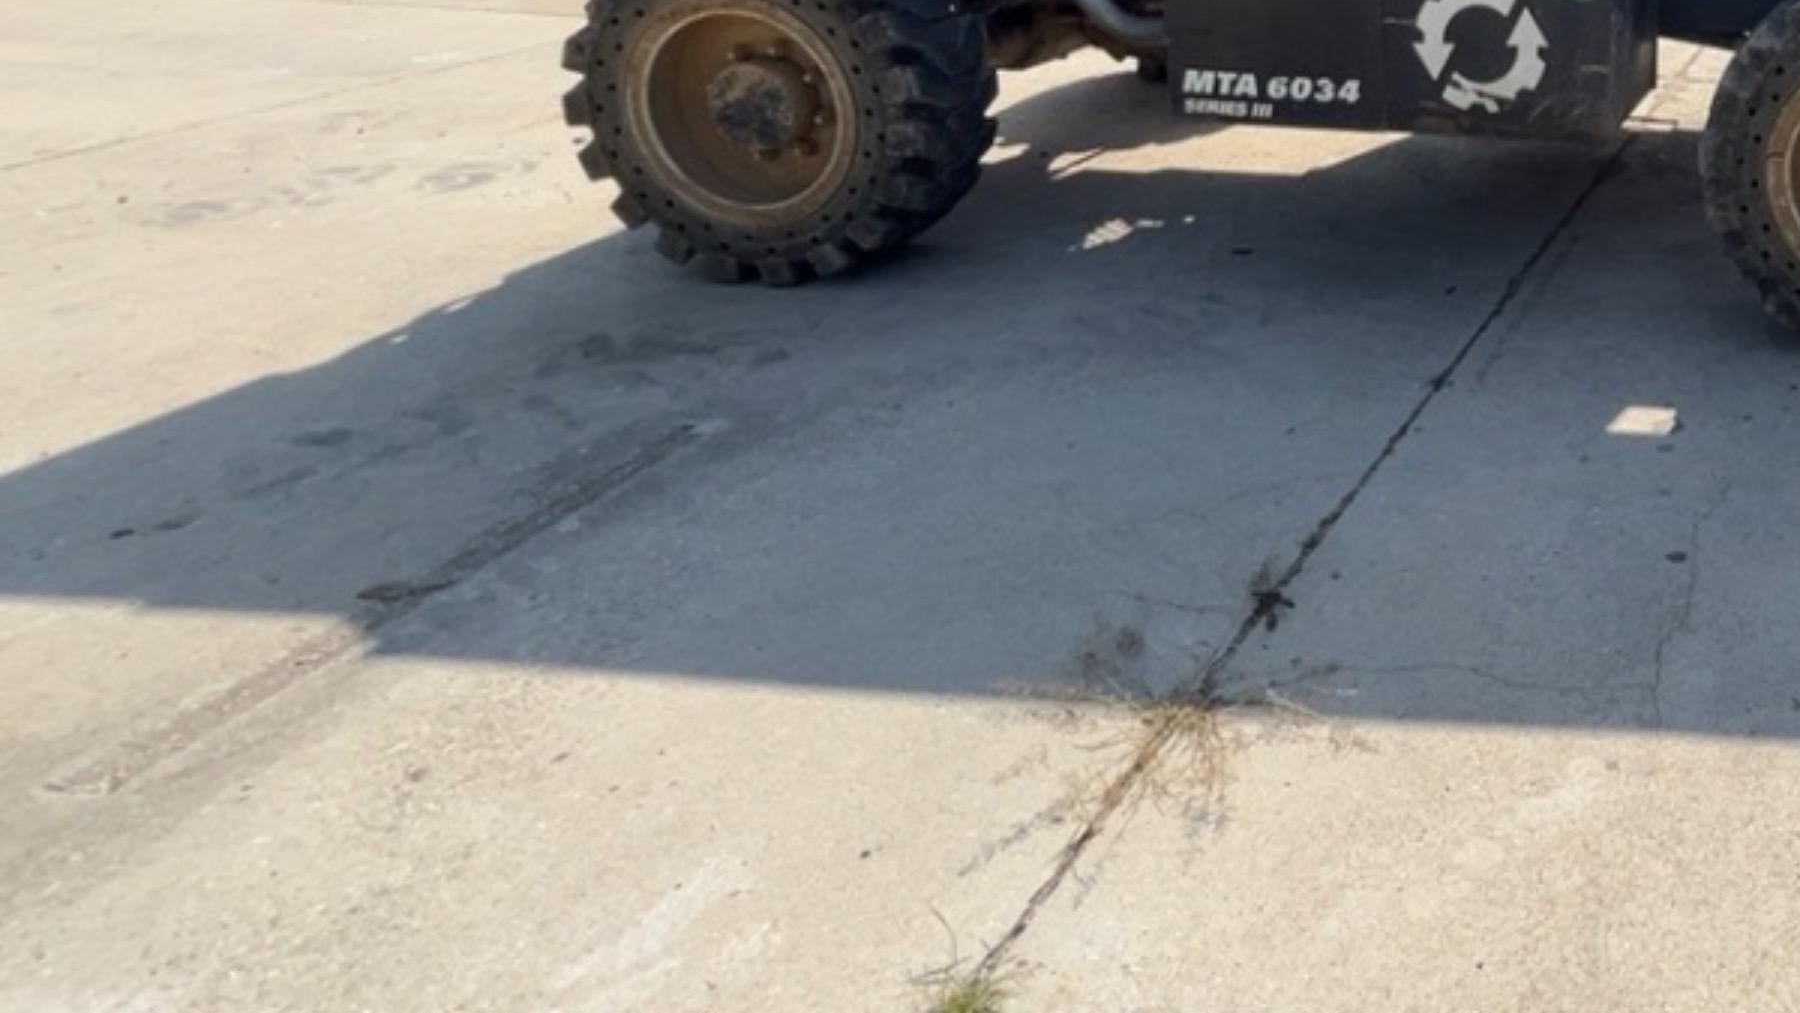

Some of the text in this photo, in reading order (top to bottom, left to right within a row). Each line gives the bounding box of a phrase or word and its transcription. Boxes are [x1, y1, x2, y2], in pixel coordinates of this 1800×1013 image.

[1183, 69, 1361, 104] MTA 6034
[1184, 98, 1249, 117] SERIES
